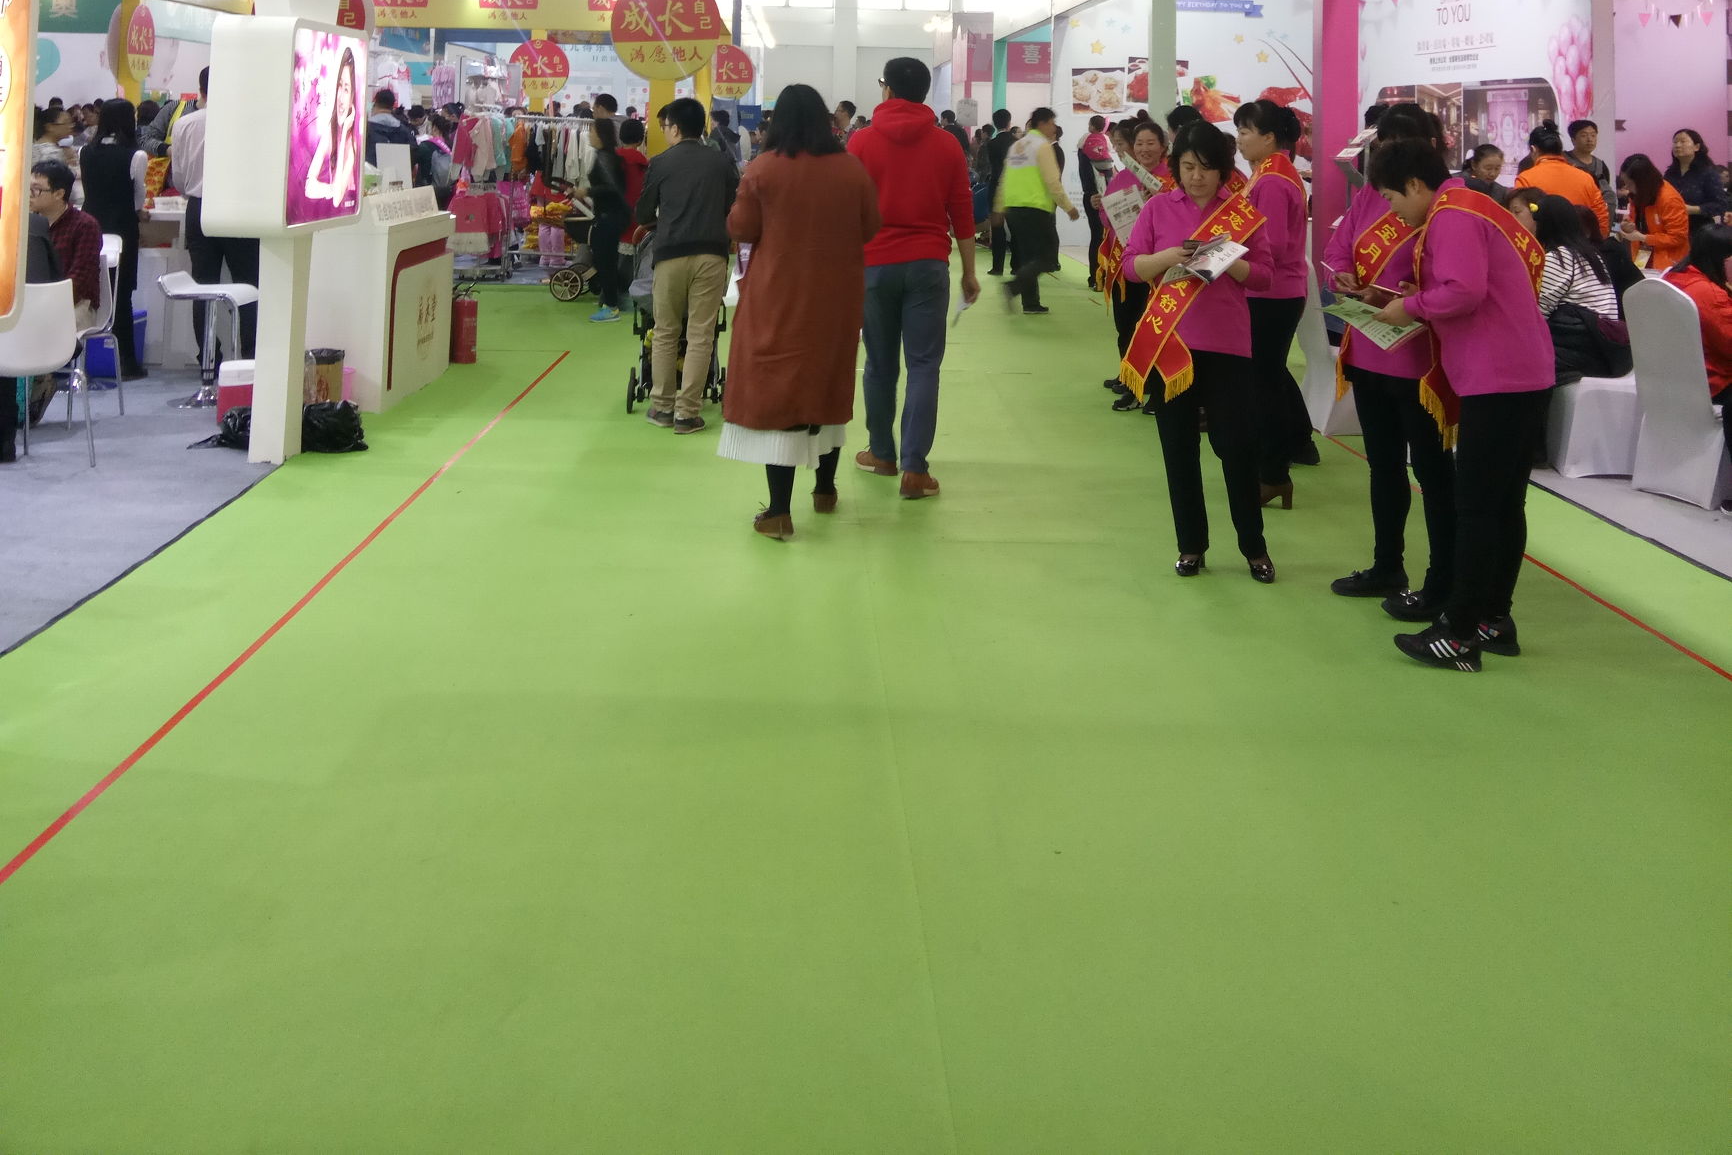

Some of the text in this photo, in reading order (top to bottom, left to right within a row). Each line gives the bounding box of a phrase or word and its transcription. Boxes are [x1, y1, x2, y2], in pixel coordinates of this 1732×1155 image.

[620, 0, 712, 37] 成长 自己
[1436, 4, 1471, 25] TO YOU
